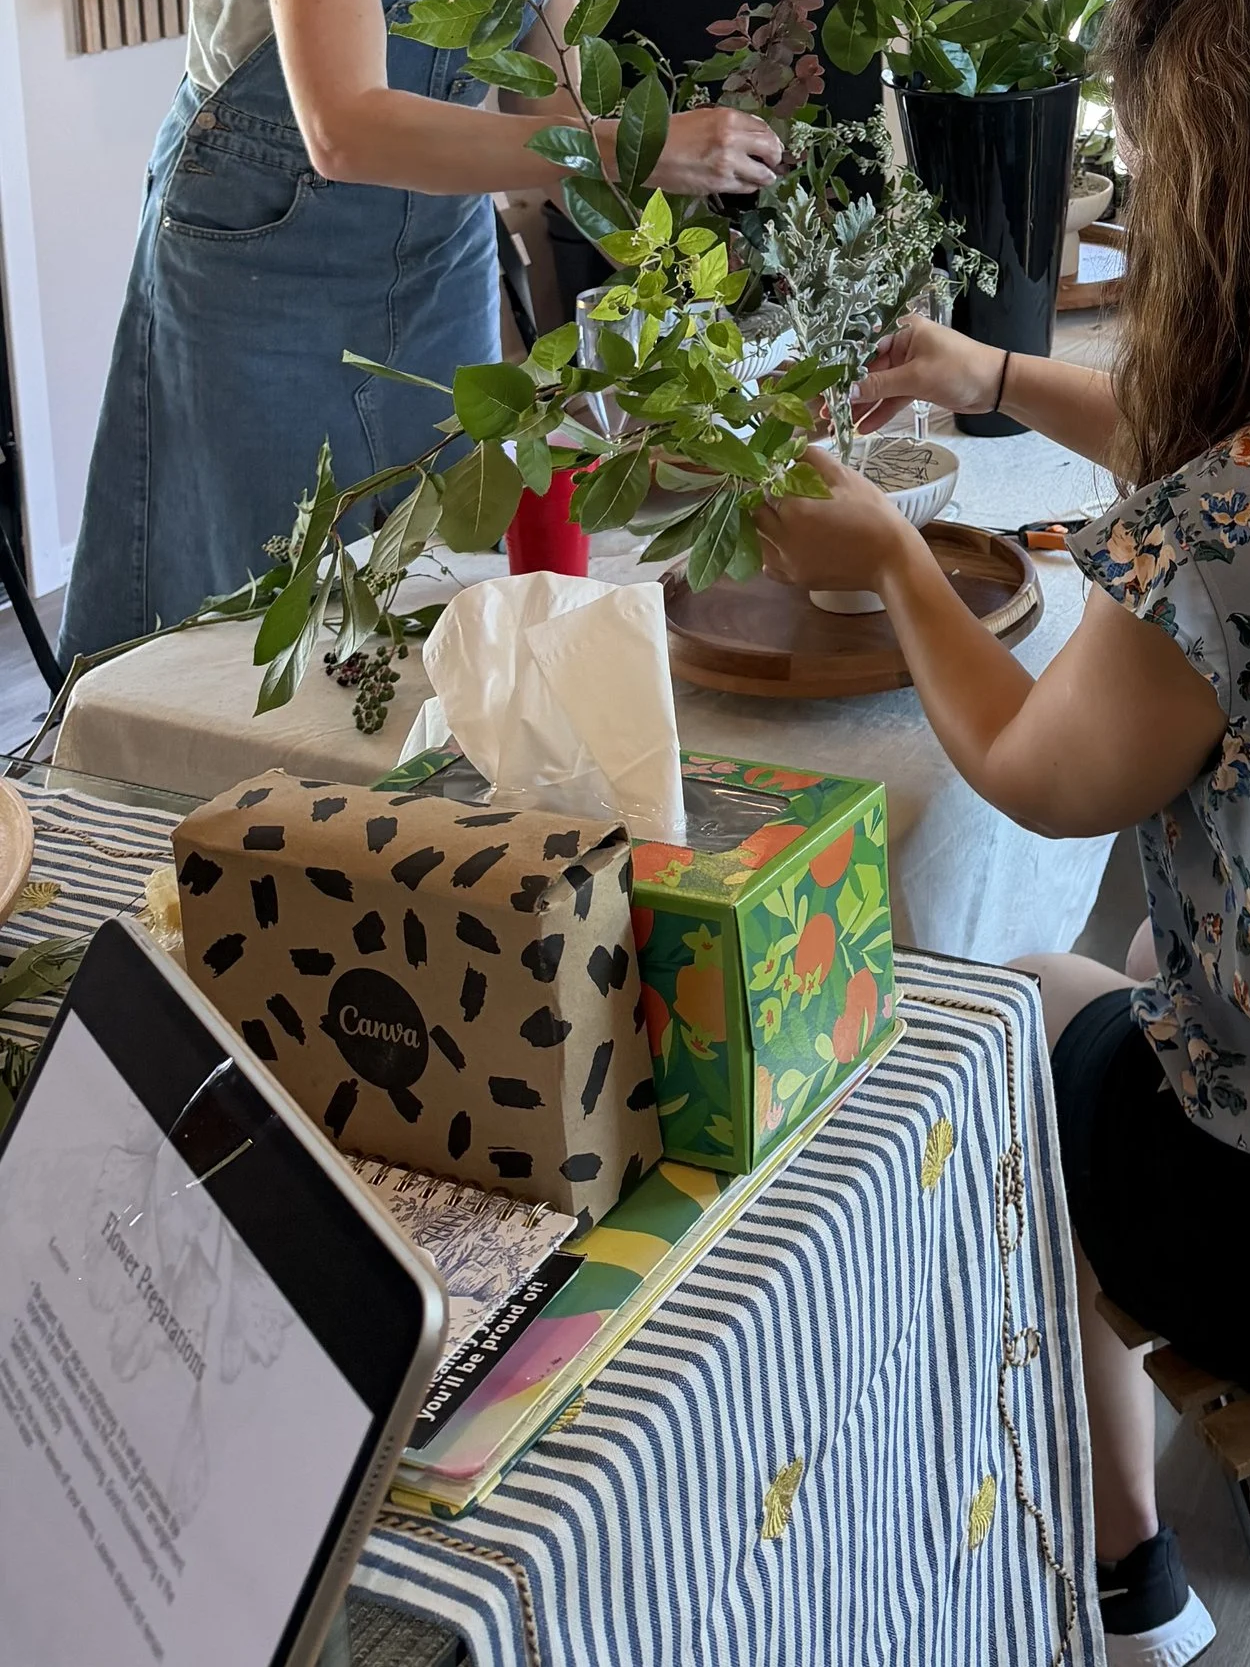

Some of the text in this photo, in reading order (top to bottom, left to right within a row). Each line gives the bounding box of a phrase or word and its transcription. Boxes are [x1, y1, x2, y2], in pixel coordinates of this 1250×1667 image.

[339, 1004, 421, 1049] Canva
[101, 1210, 207, 1382] Flower Preparations
[417, 1280, 549, 1423] you'll be proud of!
[427, 1336, 479, 1394] ealthy
